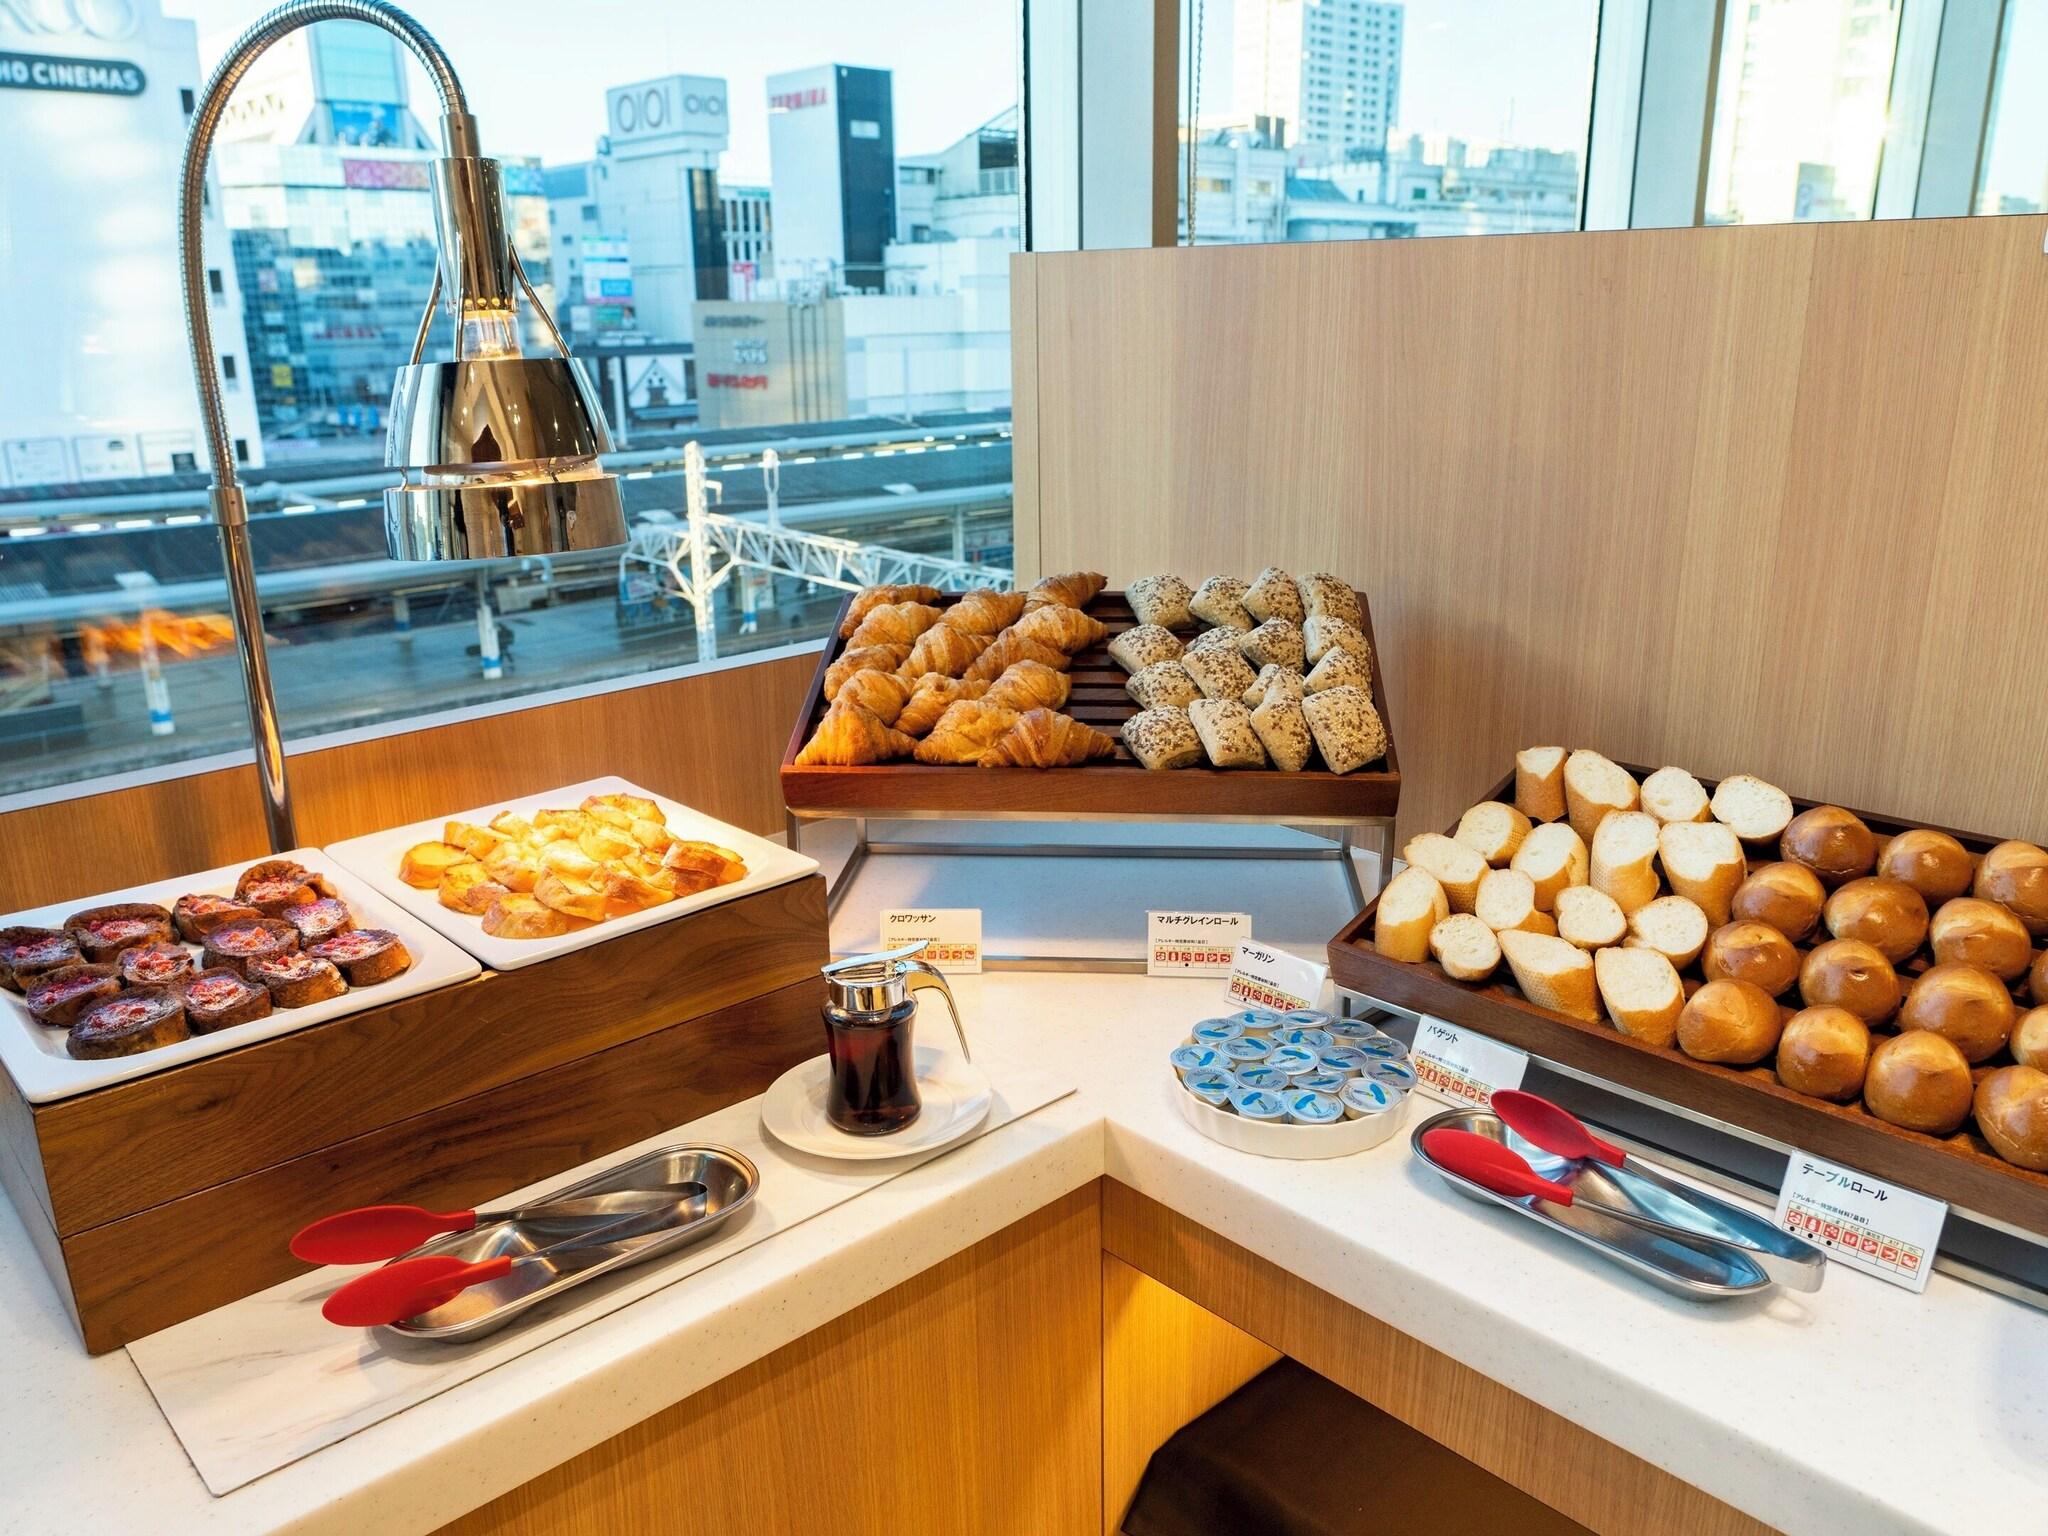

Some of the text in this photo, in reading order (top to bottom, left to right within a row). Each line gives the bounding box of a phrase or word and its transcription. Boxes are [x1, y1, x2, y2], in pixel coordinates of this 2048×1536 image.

[31, 61, 140, 91] CINEMAS
[889, 914, 937, 923] クロワッサン
[1157, 915, 1239, 926] マルチグレインロール
[1241, 946, 1275, 964] マーガリン
[1427, 1025, 1459, 1044] バゲット
[1802, 1163, 1888, 1202] テーブルロール
